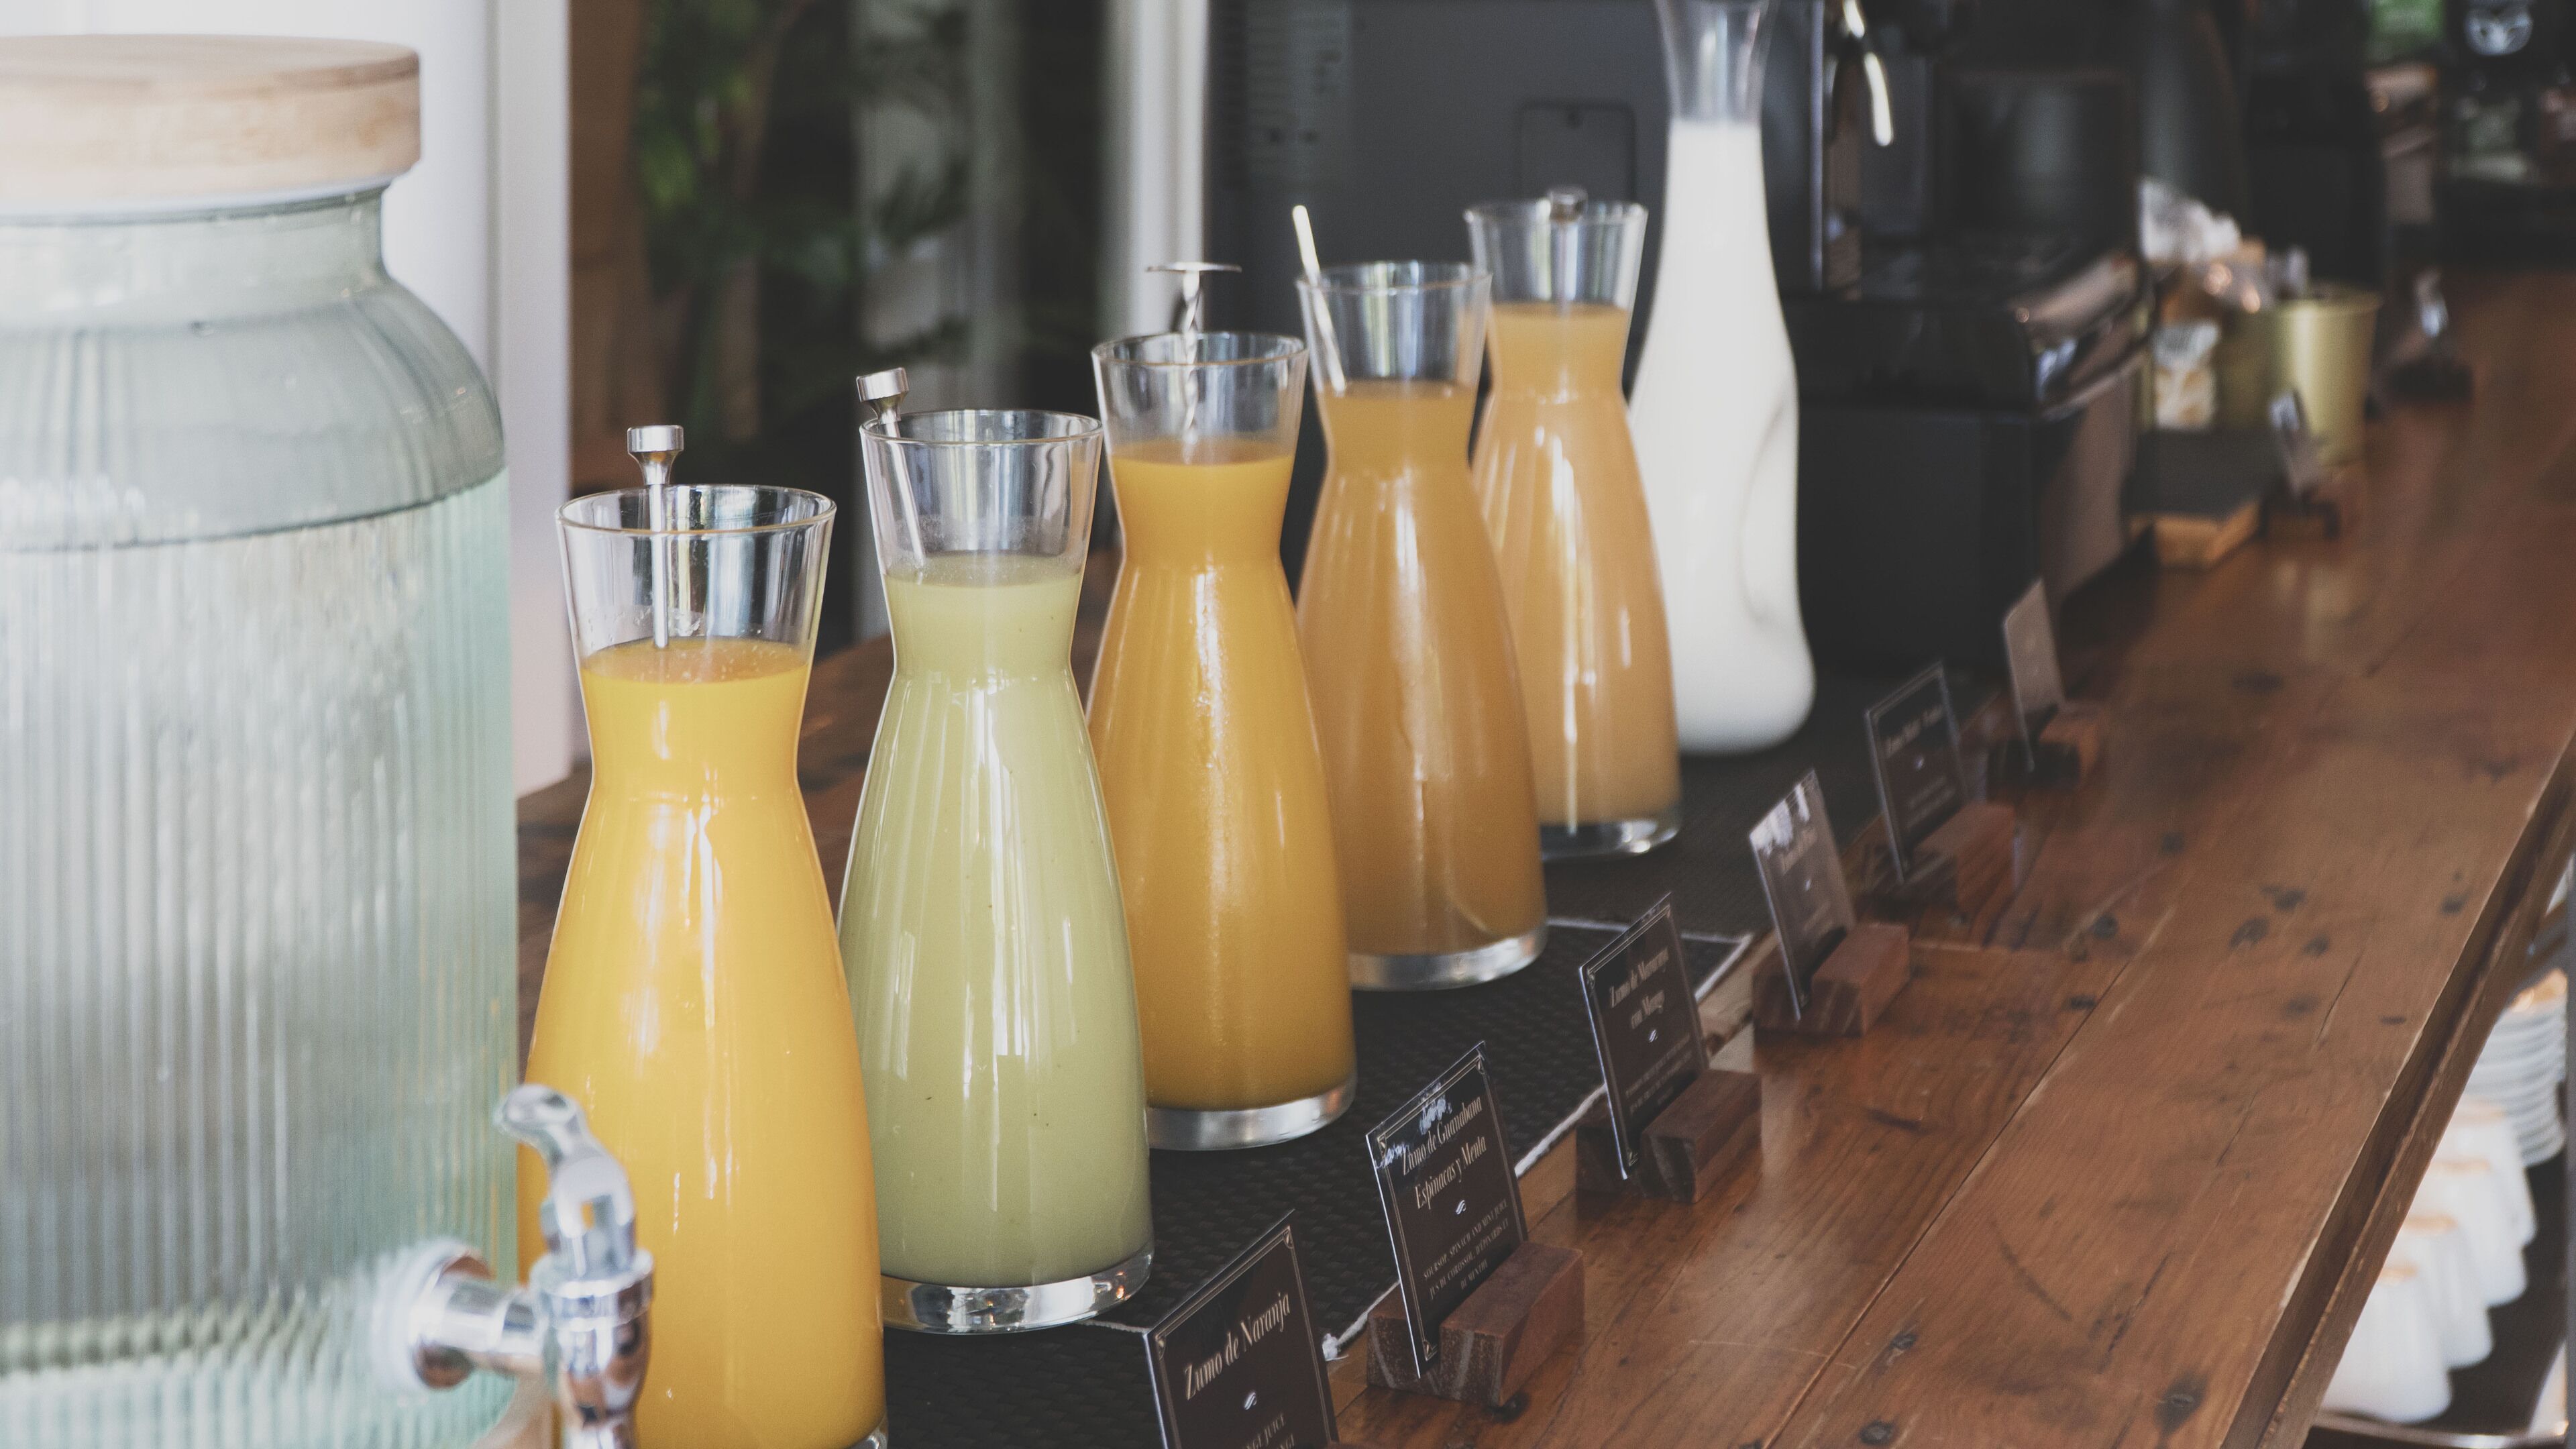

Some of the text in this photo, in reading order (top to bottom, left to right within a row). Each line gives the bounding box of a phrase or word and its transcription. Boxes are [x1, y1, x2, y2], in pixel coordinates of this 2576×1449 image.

[1403, 1096, 1483, 1177] Zumo de Guanabana
[1415, 1136, 1487, 1210] Espinacas y Menta
[1183, 1291, 1291, 1400] Zumo de Naranja
[1264, 1412, 1287, 1445] JUICE
